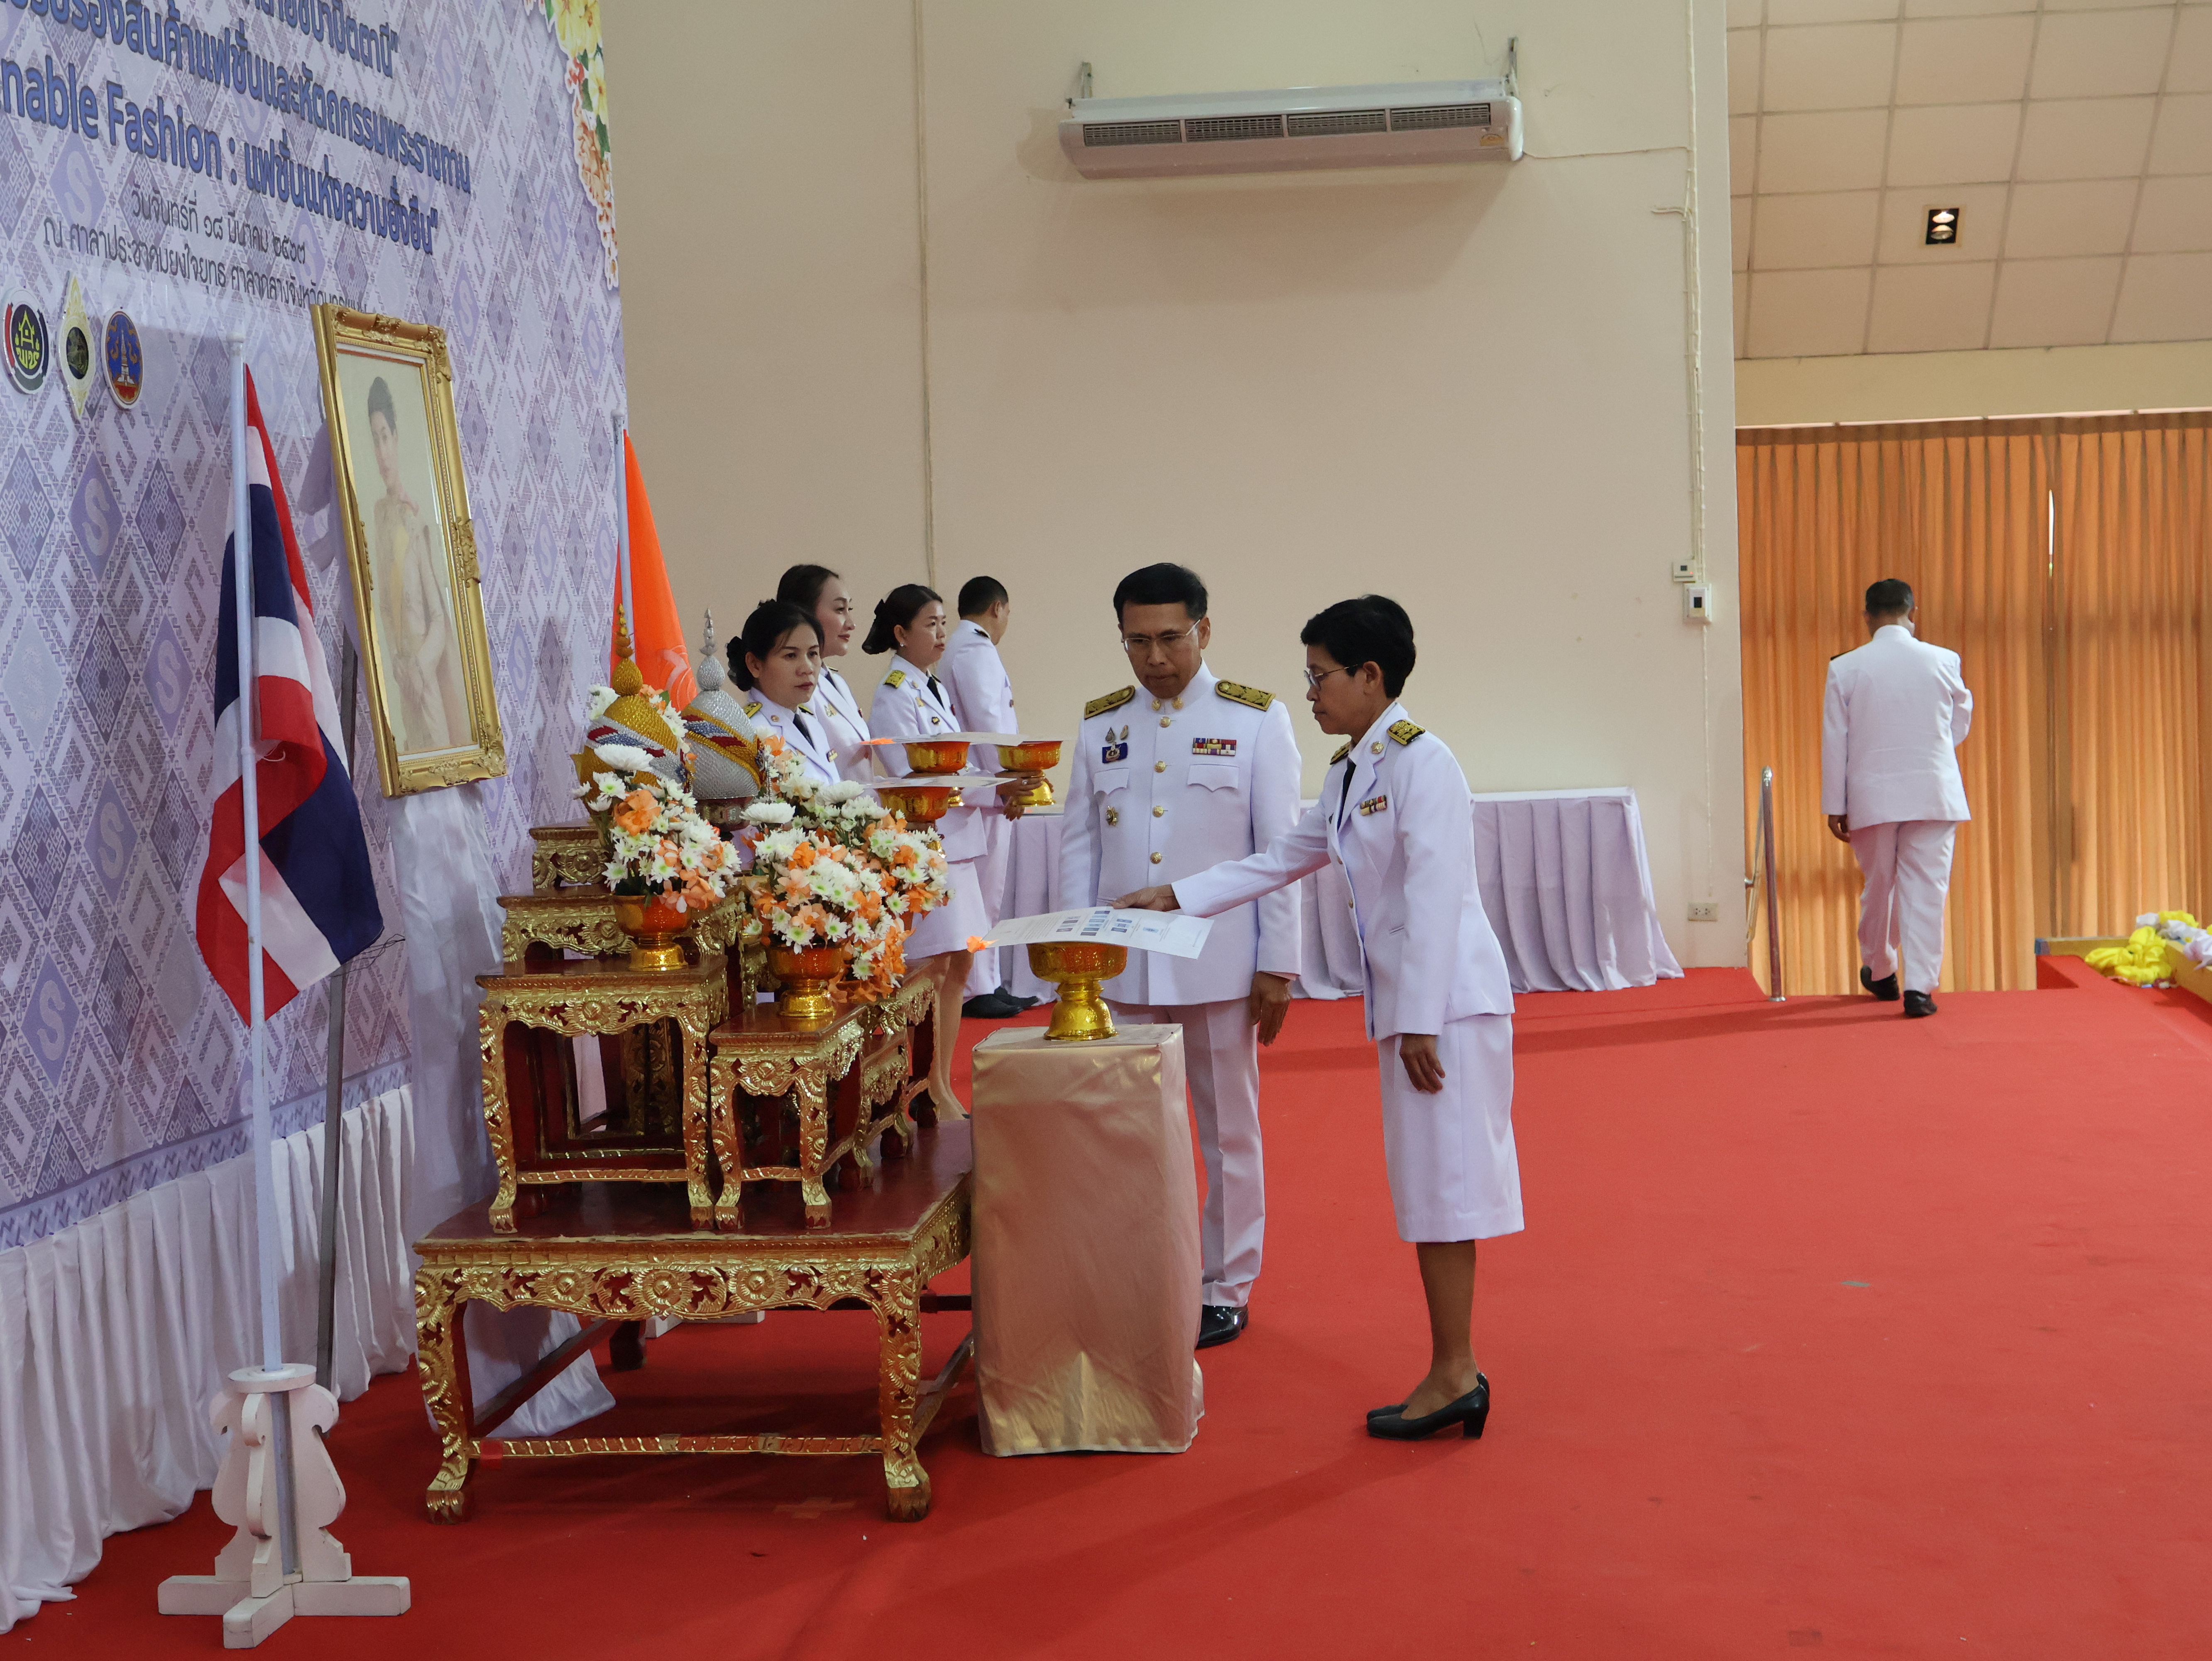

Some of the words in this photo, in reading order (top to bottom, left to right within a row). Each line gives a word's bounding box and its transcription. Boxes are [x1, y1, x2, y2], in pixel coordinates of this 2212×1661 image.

[1, 55, 99, 140] nable
[107, 81, 222, 180] Fashion
[228, 210, 268, 253] มีนาคม
